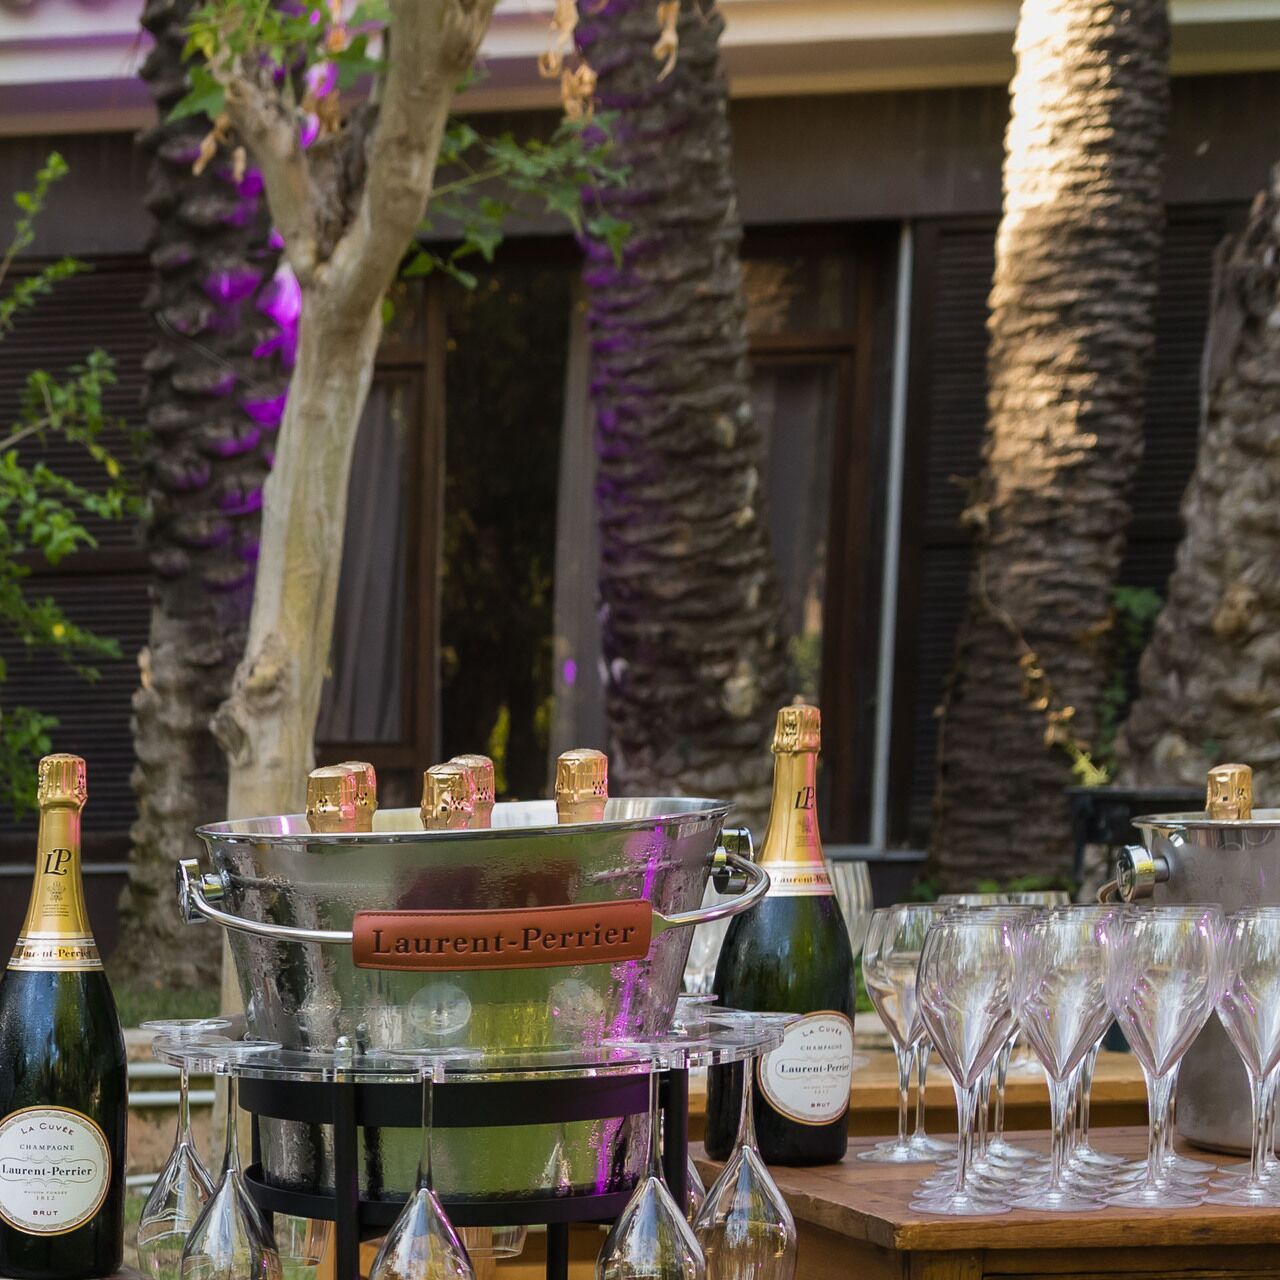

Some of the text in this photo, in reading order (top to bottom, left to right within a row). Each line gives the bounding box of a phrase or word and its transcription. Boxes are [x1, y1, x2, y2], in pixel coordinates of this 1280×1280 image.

[372, 923, 636, 955] Laurent-Perrier
[781, 1063, 850, 1073] Laurent-Perrier
[19, 1143, 75, 1151] CHAMPAGNE
[2, 1164, 93, 1176] Laurent-Perrier
